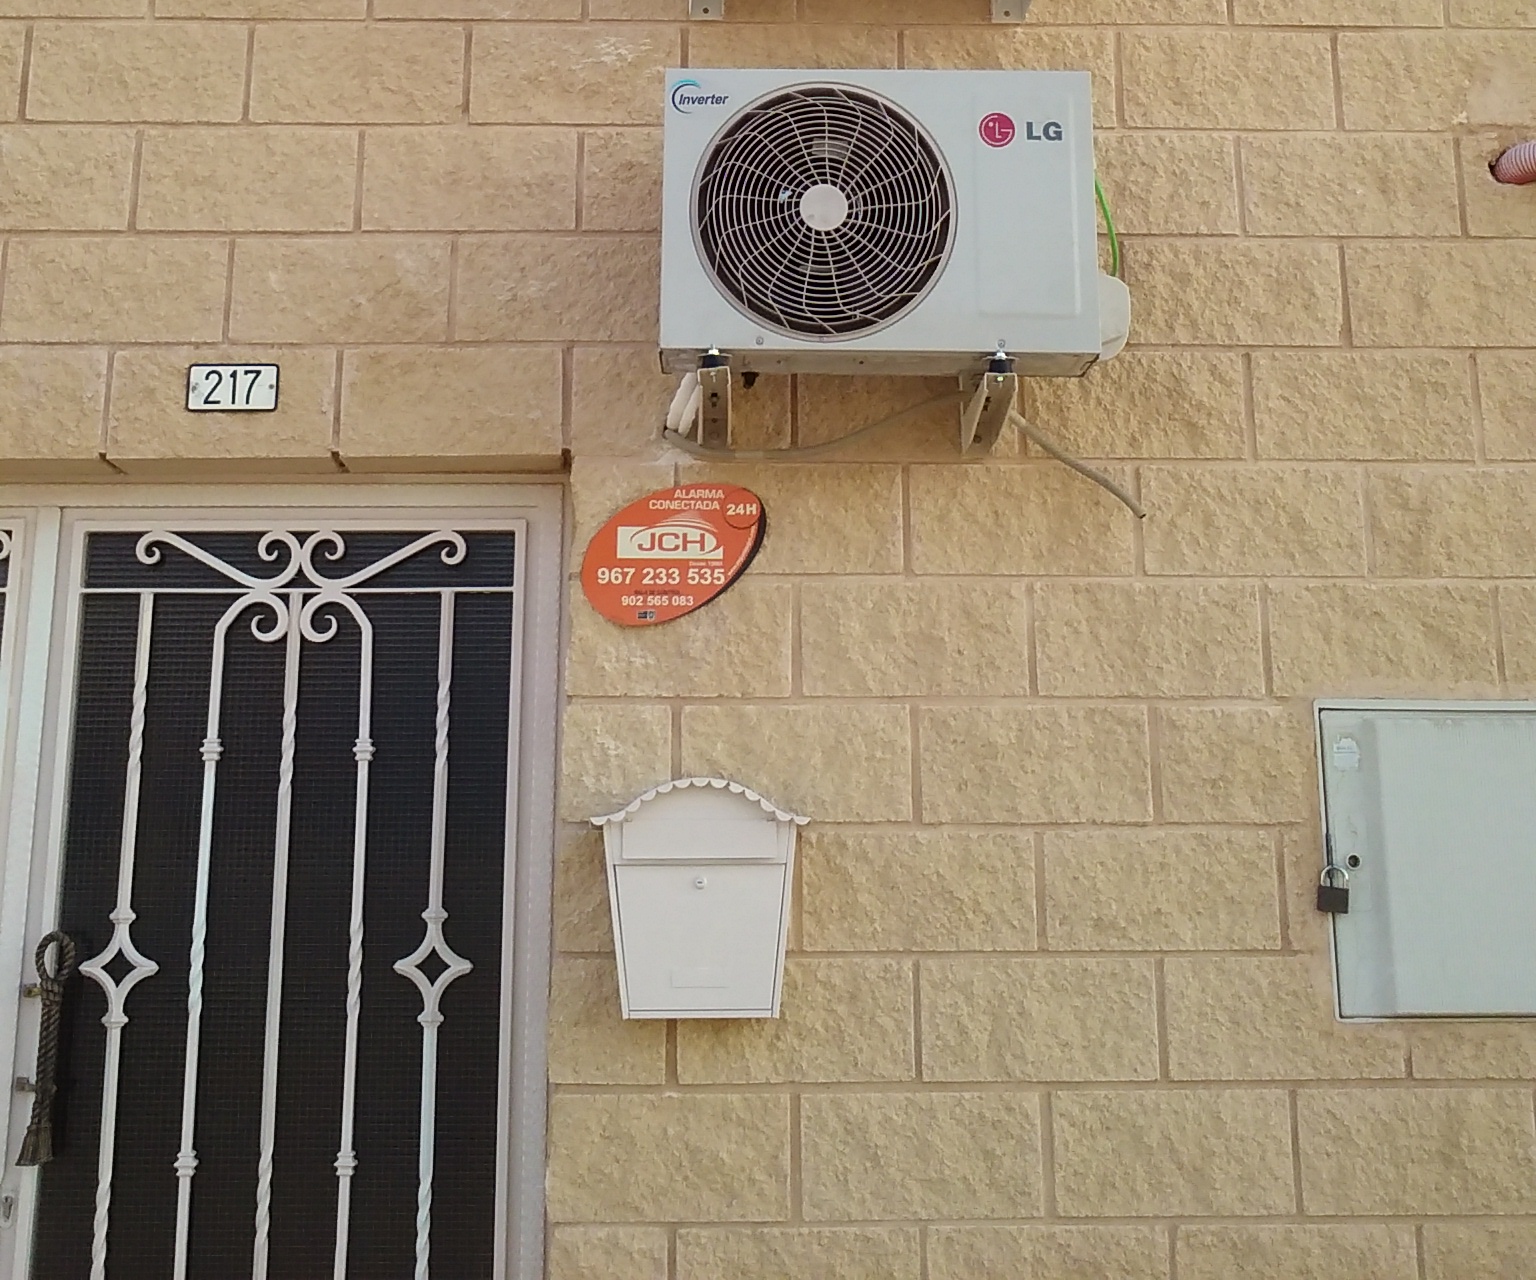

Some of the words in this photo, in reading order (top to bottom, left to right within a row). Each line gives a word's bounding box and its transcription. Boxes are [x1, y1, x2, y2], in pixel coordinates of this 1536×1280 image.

[678, 93, 730, 106] Inverter
[1026, 121, 1063, 141] LG
[203, 369, 262, 405] 217
[674, 489, 725, 499] ALARMA
[649, 500, 720, 510] CONECTADA
[726, 503, 757, 516] 24H
[637, 532, 707, 552] JCH
[597, 567, 636, 585] 967
[641, 567, 681, 585] 233
[687, 568, 726, 585] 535
[621, 595, 644, 606] 902
[647, 595, 669, 606] 565
[671, 595, 694, 606] 083
